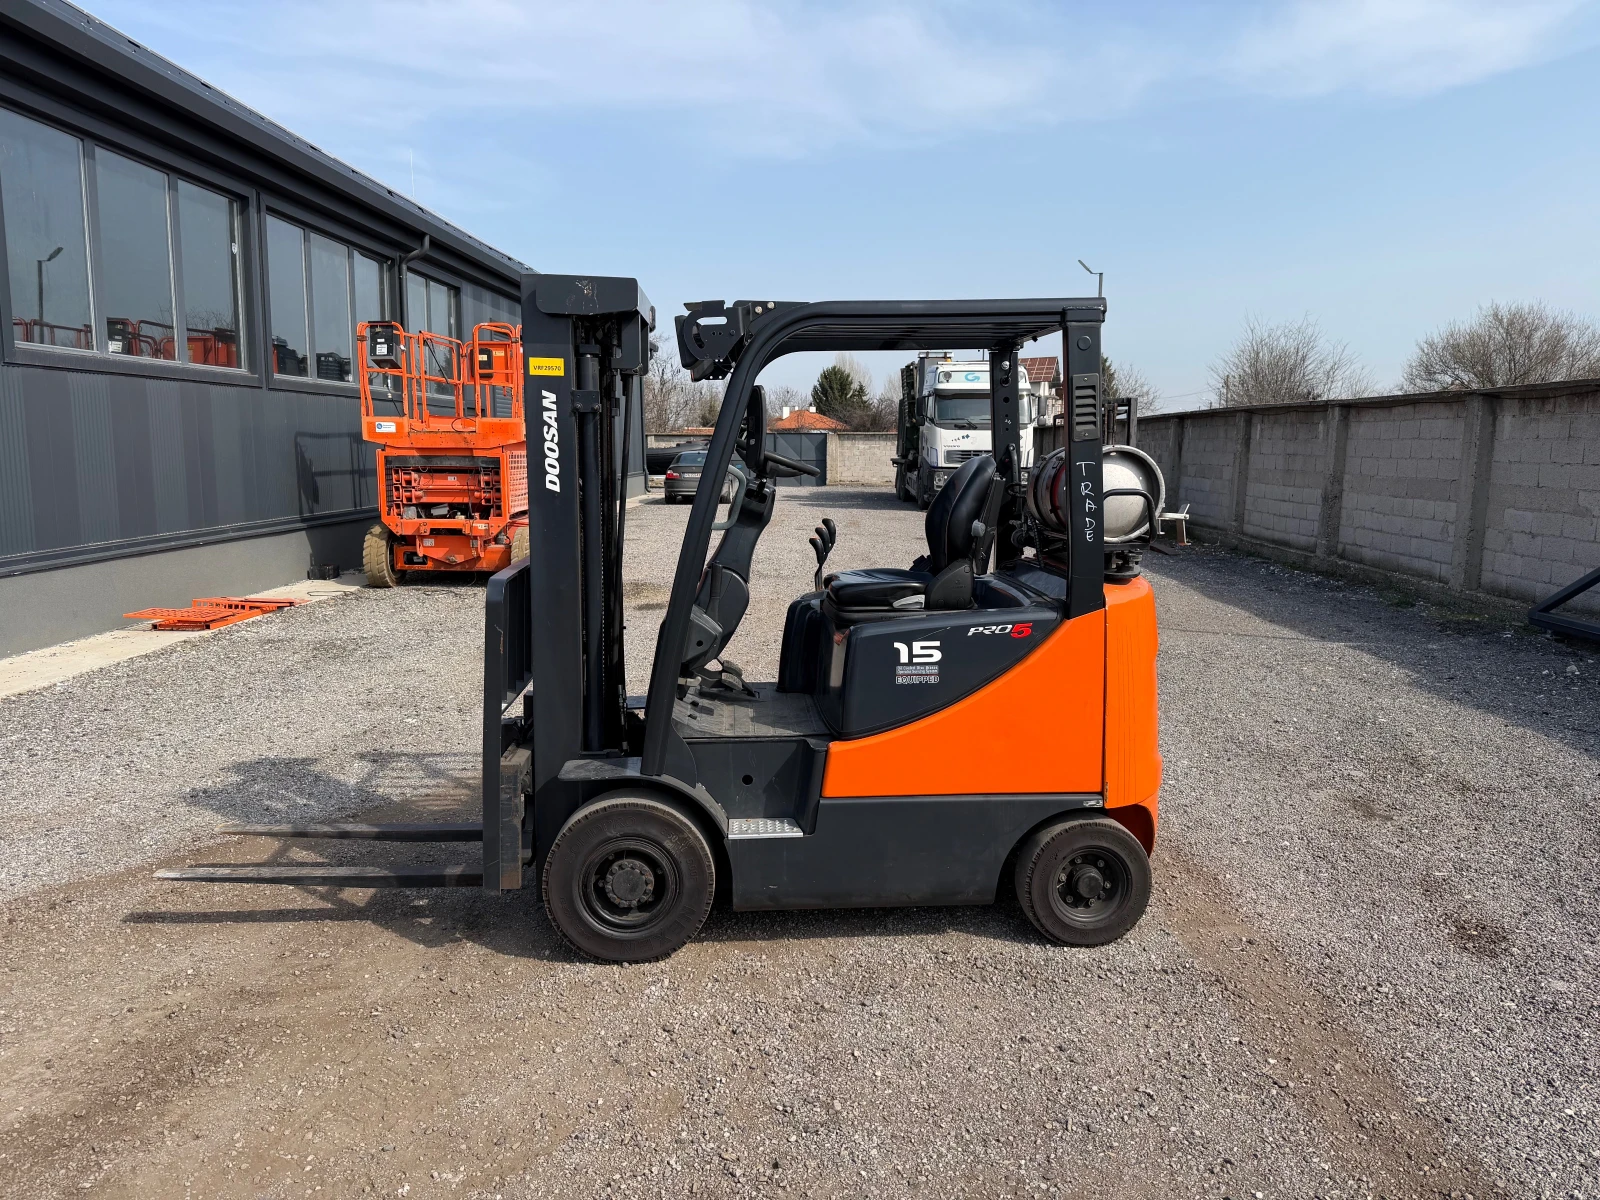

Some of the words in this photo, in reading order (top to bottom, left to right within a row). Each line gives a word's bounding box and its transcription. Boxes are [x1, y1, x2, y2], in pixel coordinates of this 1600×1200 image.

[541, 389, 561, 493] DOOSAN
[1076, 461, 1098, 542] TRADE
[893, 640, 943, 664] 15
[895, 675, 940, 685] EQUIPPED
